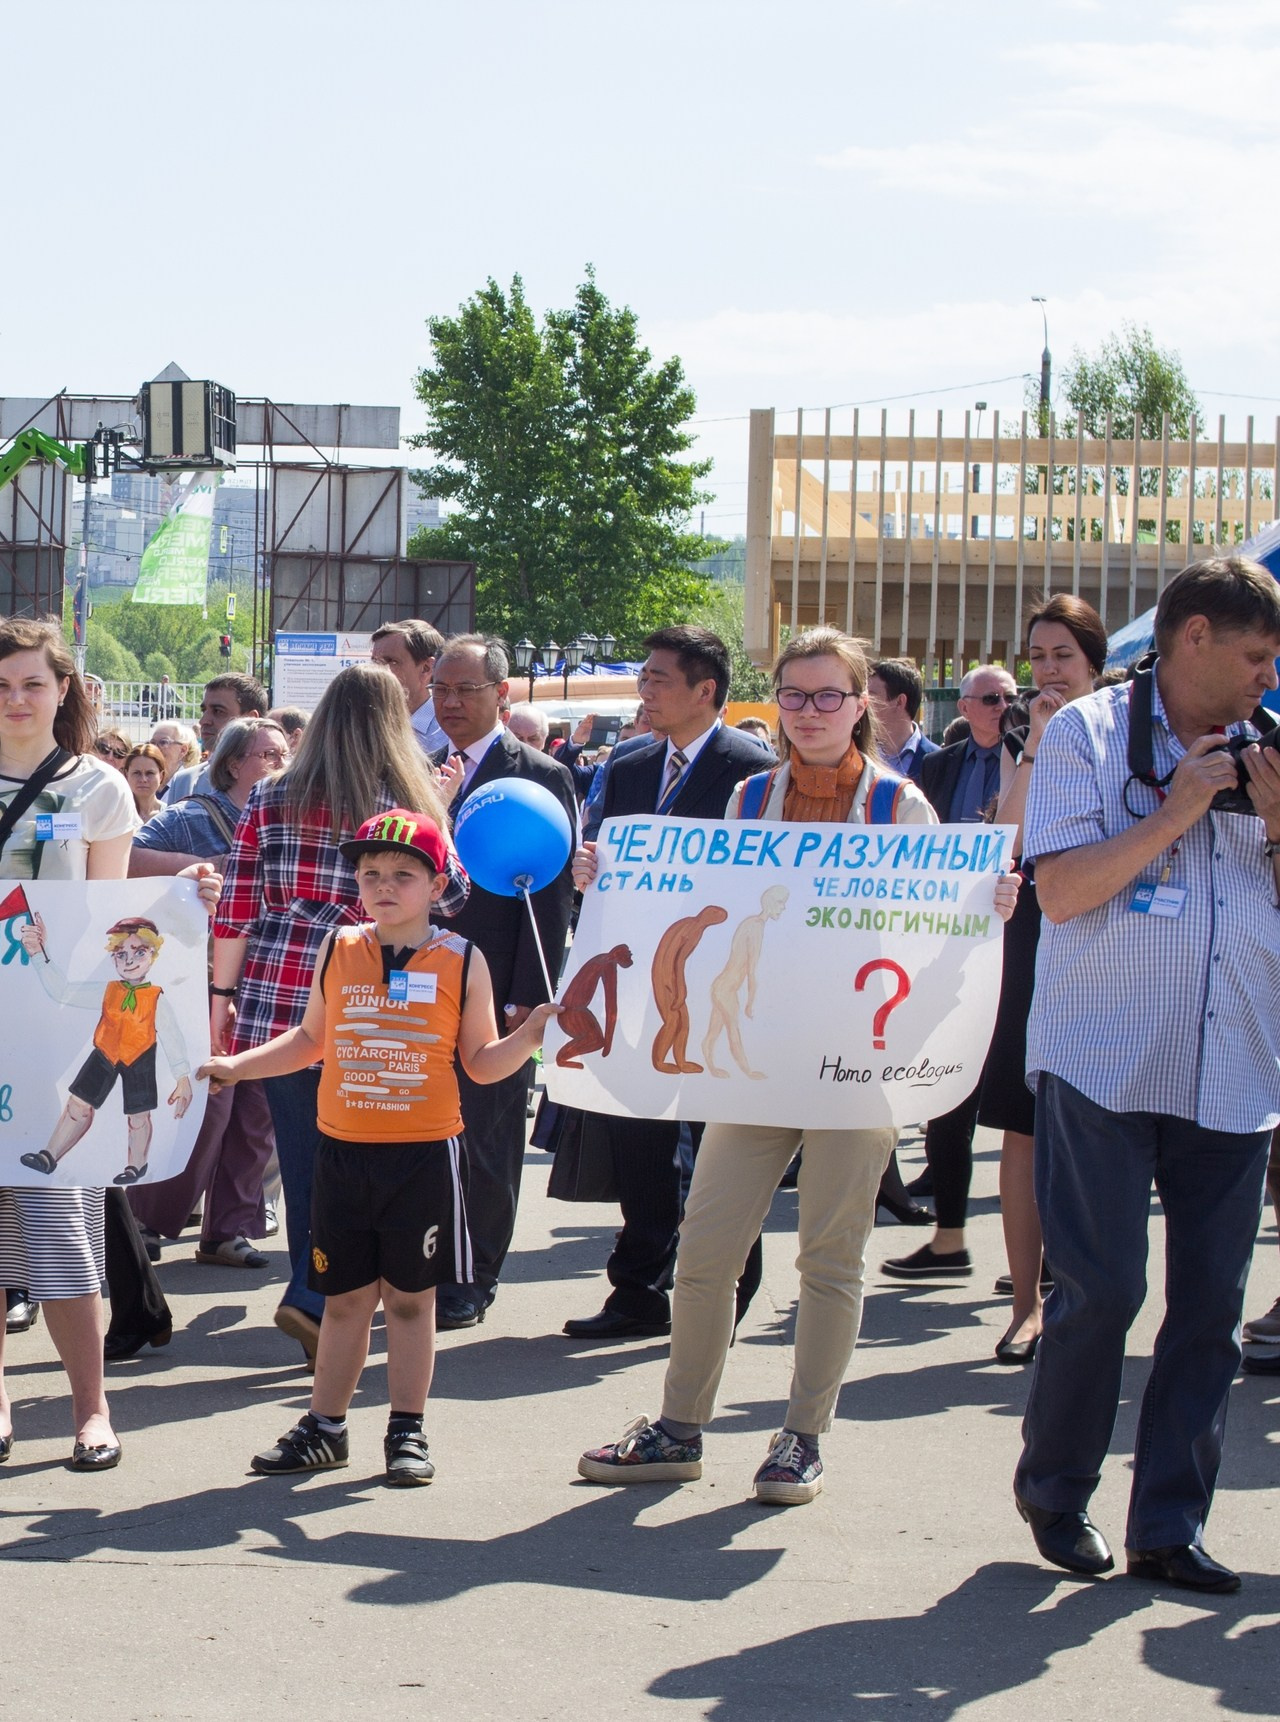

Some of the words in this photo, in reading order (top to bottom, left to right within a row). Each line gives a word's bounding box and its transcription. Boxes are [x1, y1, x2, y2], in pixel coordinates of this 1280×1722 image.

[607, 824, 790, 867] ЧЕЛОВЕК
[597, 870, 694, 893] СТАНЬ
[812, 876, 960, 903] ЧЕЛОВЕКОМ
[805, 906, 990, 938] ЭКОЛОГИЧНЫМ
[342, 985, 375, 995] BICCI
[346, 995, 409, 1011] JUNIOR
[336, 1047, 360, 1058] CYCY
[360, 1049, 427, 1063] ARCHIVES
[388, 1061, 420, 1073] PARIS
[820, 1055, 871, 1083] Homo
[343, 1071, 376, 1083] GOOD
[376, 1102, 410, 1112] FASHION
[423, 1225, 439, 1259] 6
